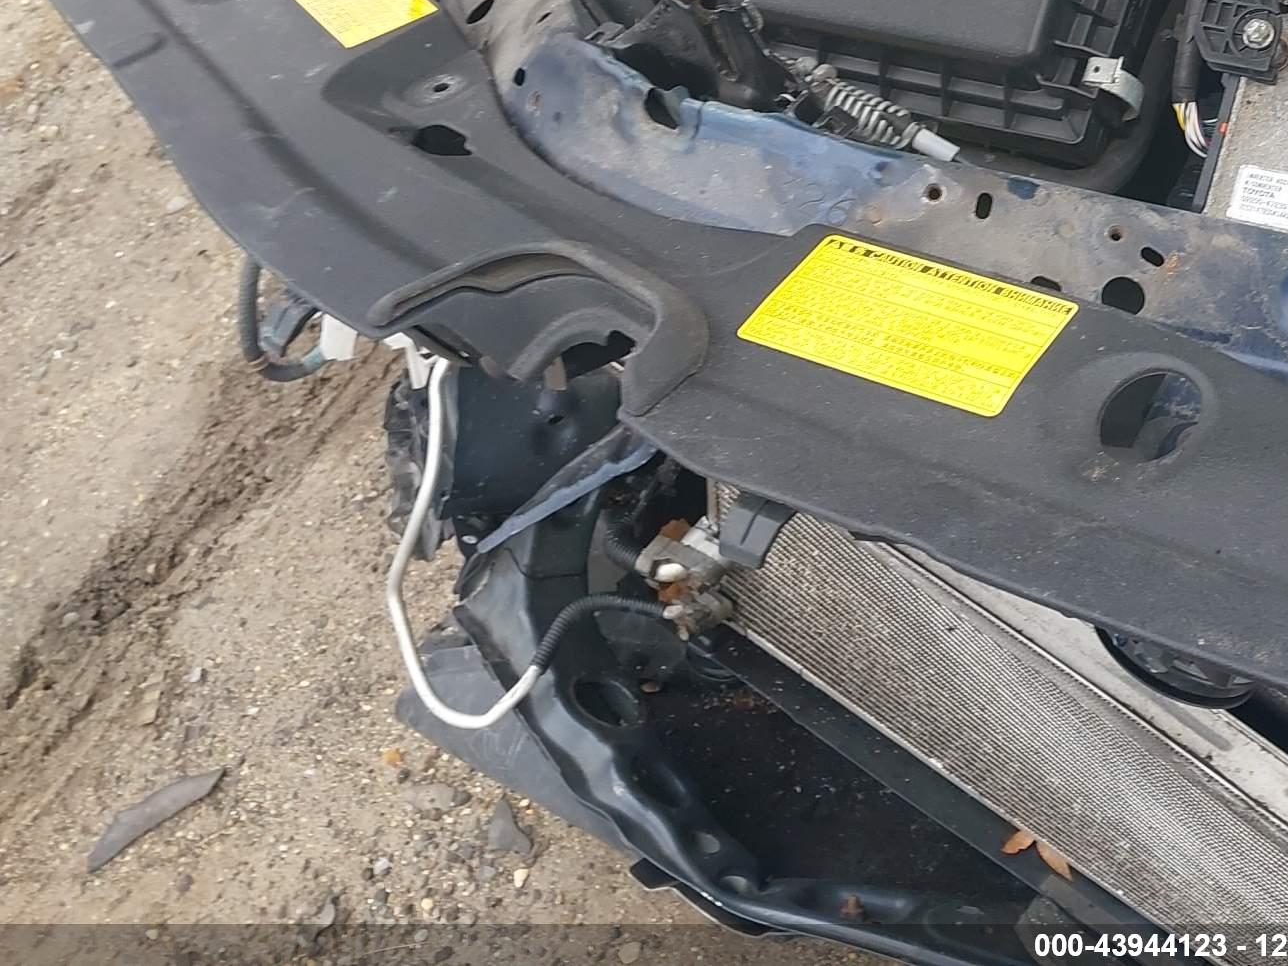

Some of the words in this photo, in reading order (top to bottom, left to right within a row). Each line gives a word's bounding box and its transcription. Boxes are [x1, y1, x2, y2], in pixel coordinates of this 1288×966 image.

[1241, 186, 1276, 199] TOYOTA
[868, 250, 926, 274] CAUTION
[928, 266, 998, 294] ATTENTION
[999, 286, 1071, 315] ВНИМАНИЕ
